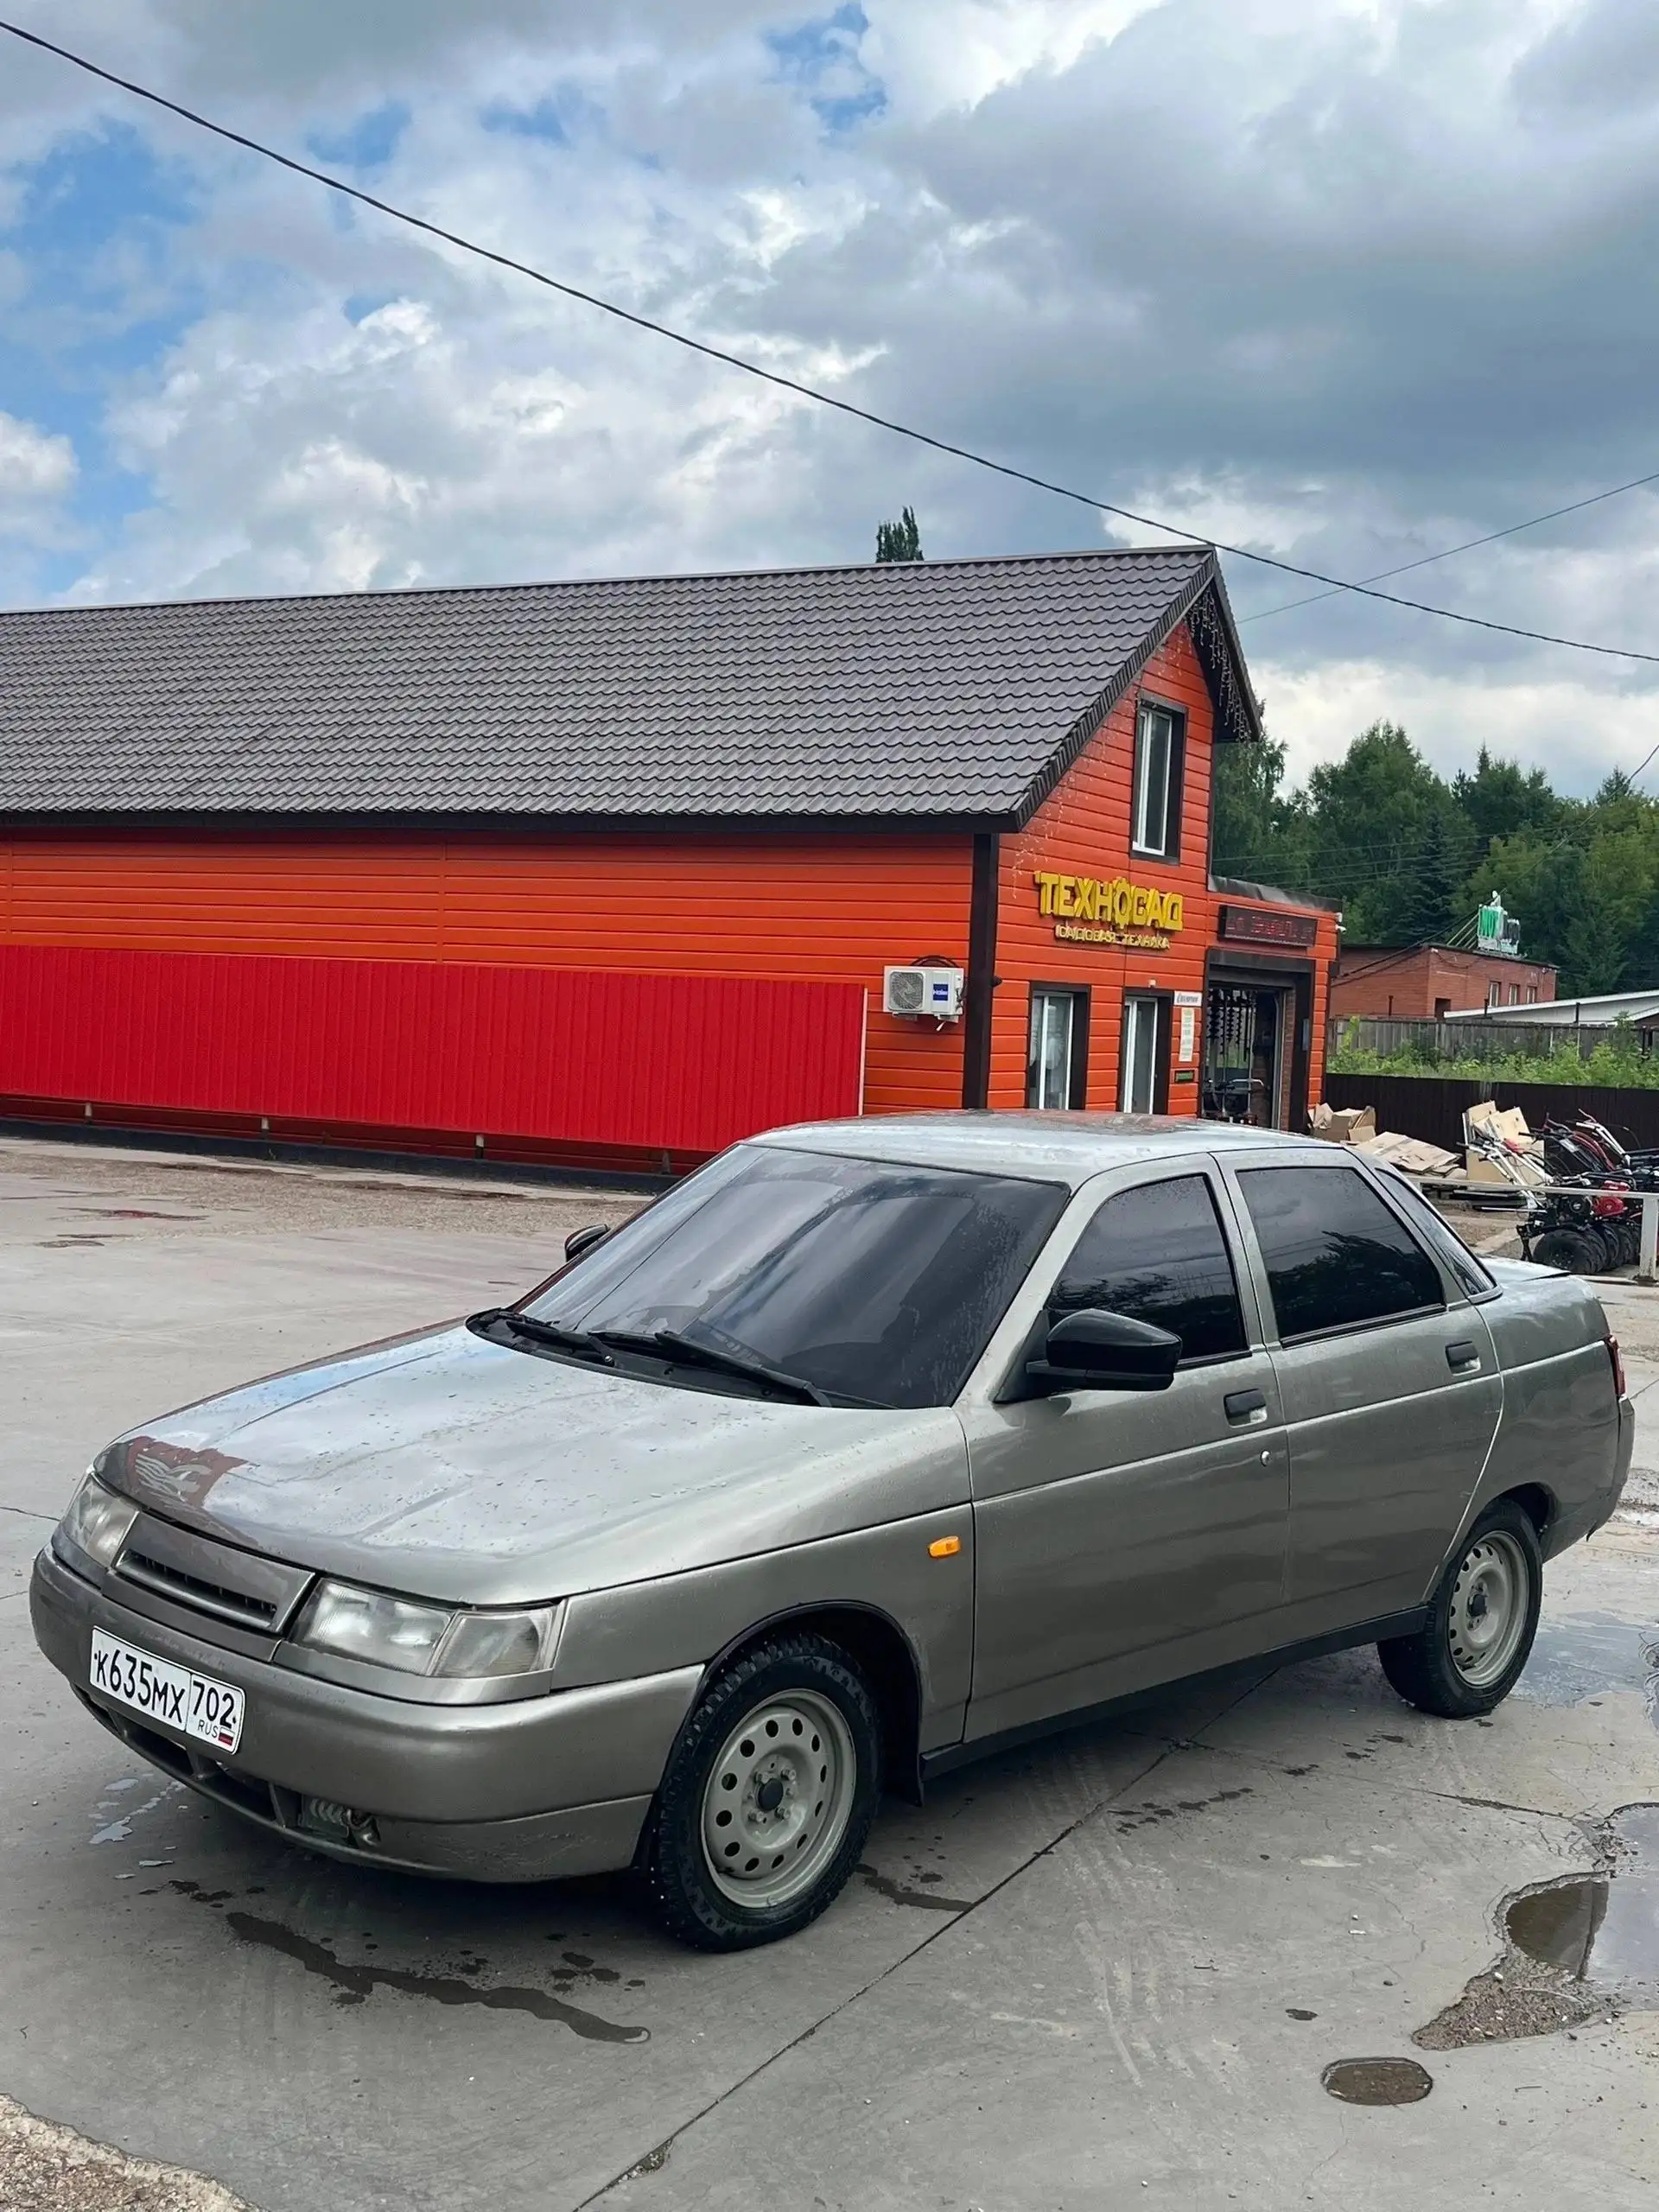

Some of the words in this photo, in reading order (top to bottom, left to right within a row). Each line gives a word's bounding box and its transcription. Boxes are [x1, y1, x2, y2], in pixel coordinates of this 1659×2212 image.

[1033, 870, 1183, 931] ТЕХНОСАД
[1055, 925, 1117, 944] САДОВАЯ
[193, 1680, 235, 1729] 702
[197, 1719, 218, 1738] RUS
